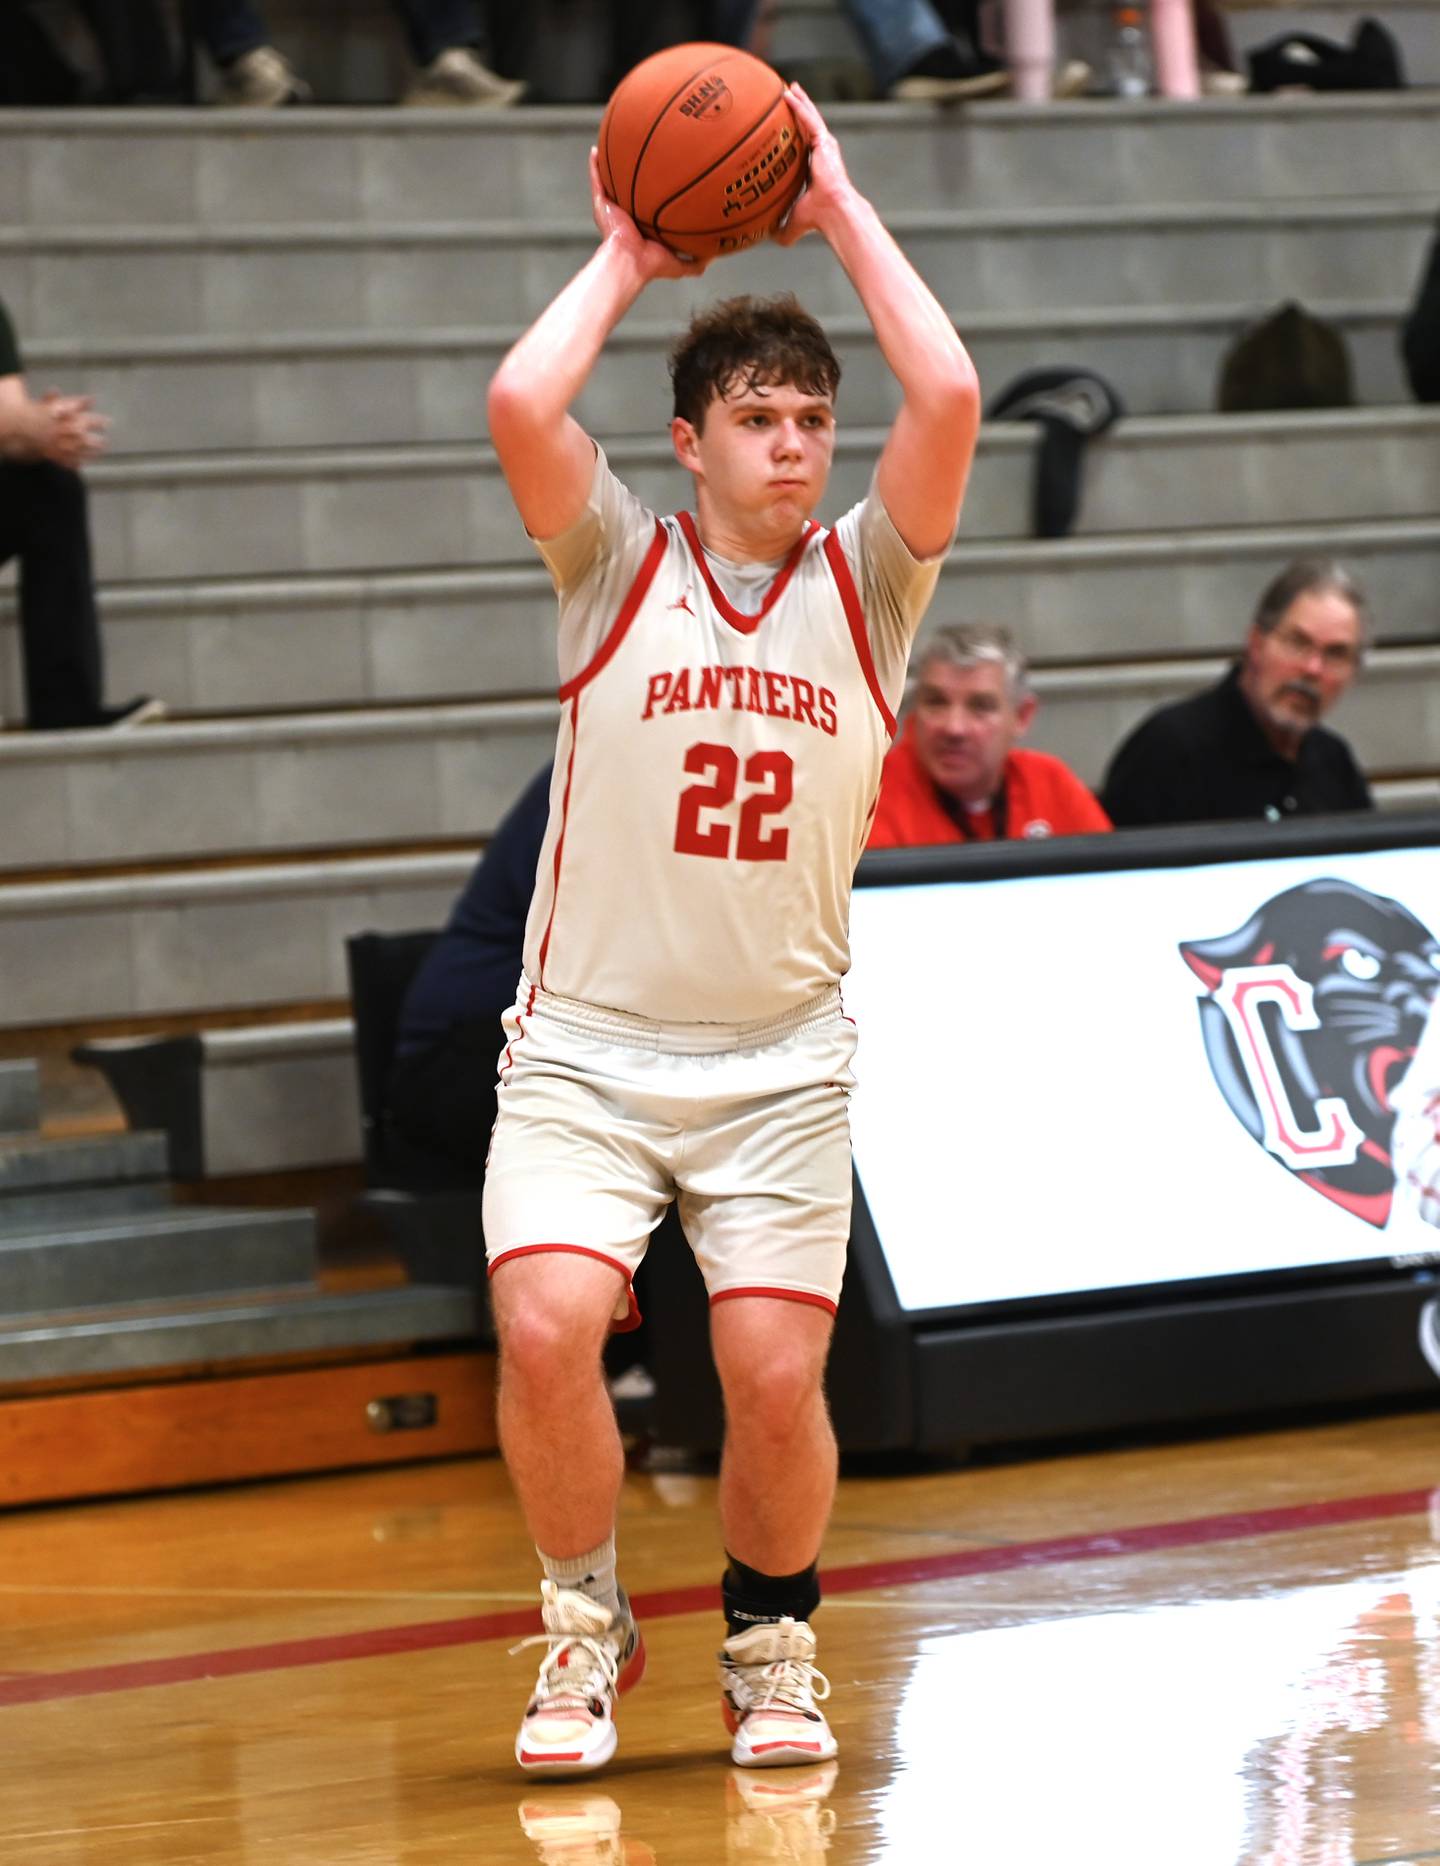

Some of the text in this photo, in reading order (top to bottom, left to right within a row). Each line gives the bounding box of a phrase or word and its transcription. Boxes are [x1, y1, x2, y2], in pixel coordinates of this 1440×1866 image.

[722, 143, 798, 218] EGACY
[641, 664, 838, 737] PANTHERS
[673, 741, 794, 862] 22
[1213, 964, 1365, 1170] C
